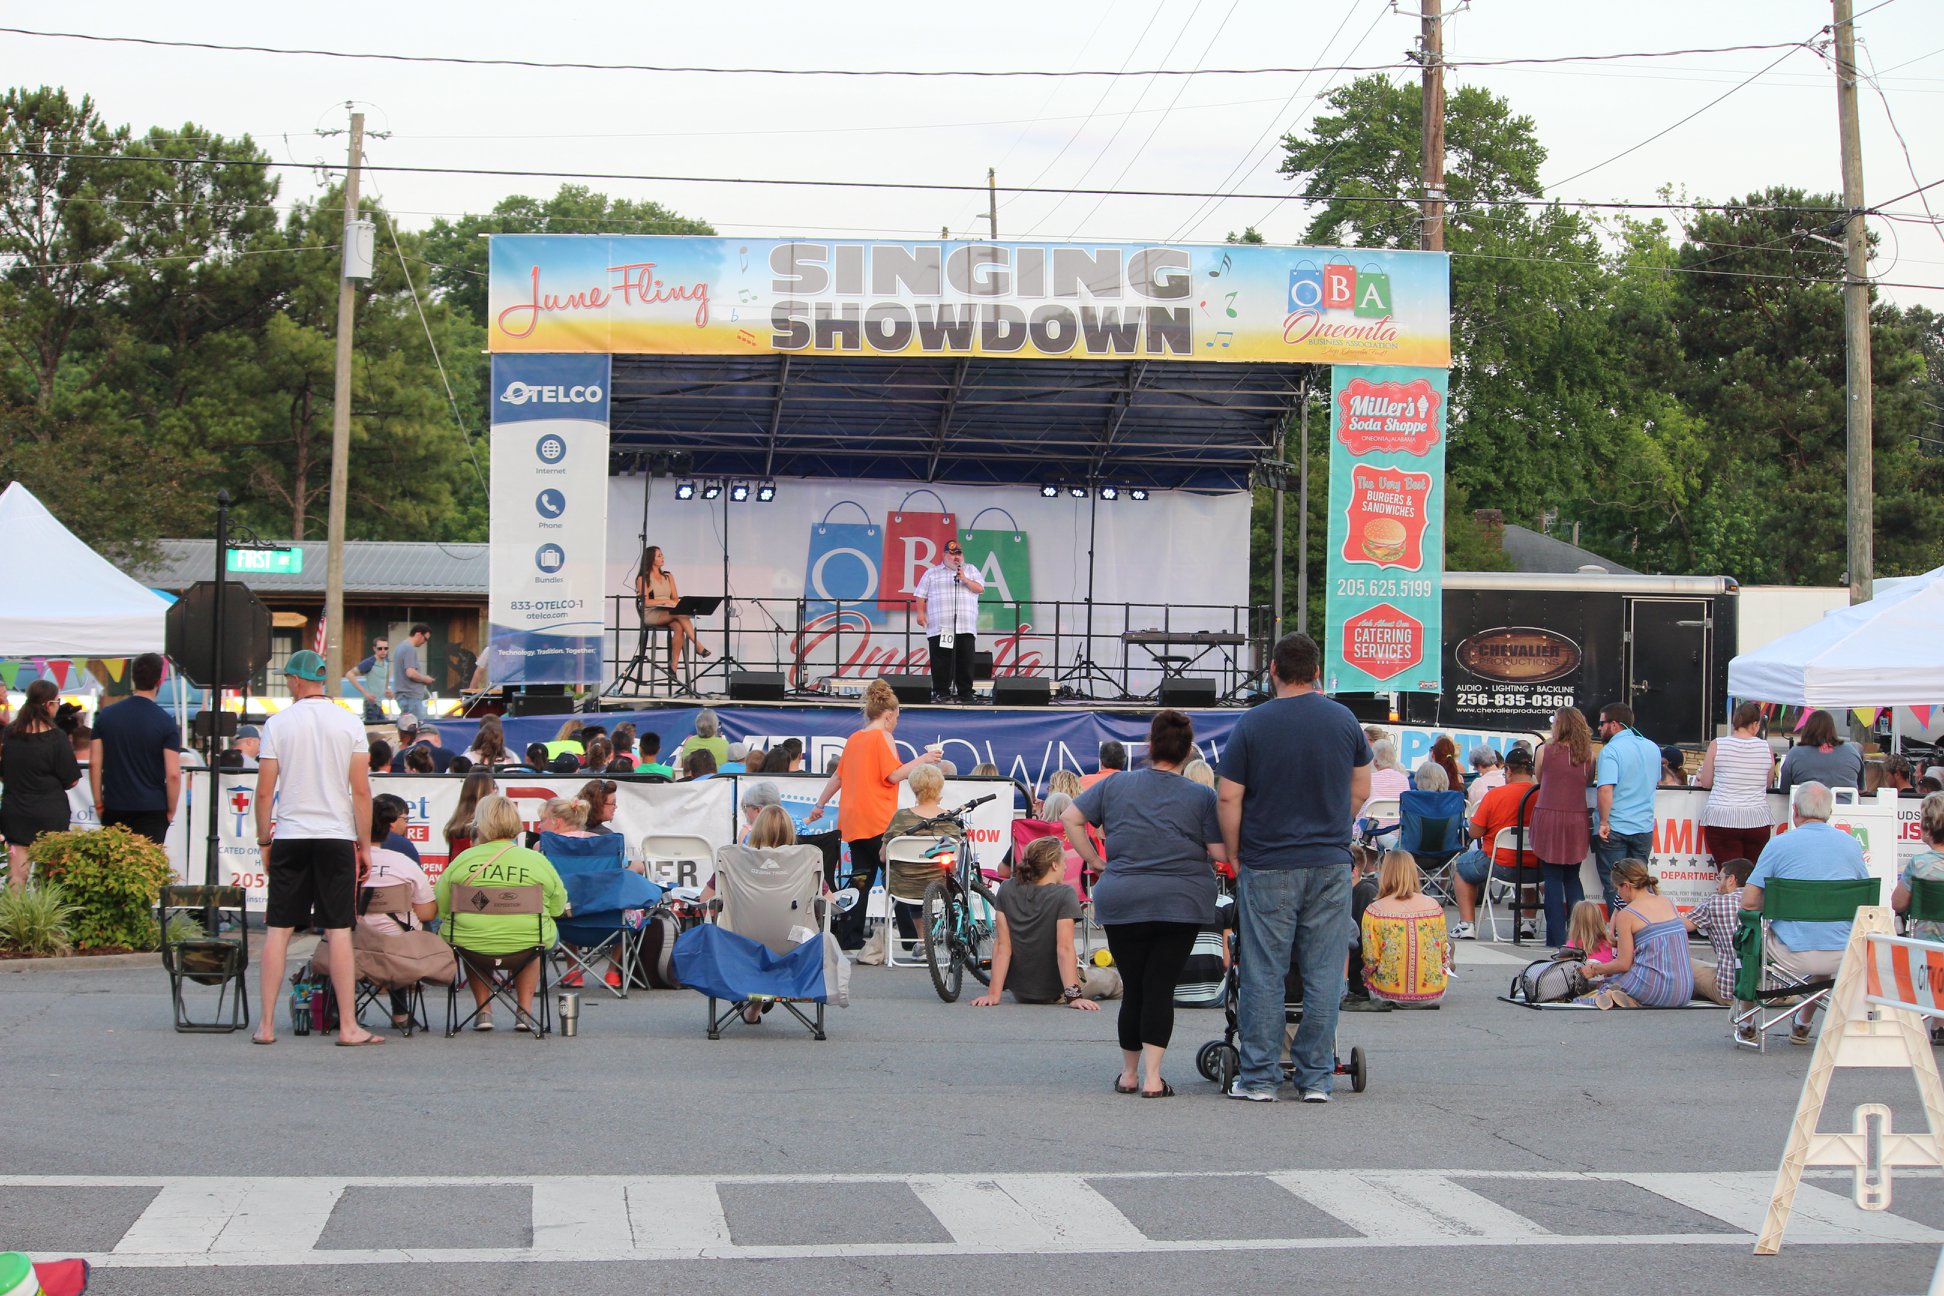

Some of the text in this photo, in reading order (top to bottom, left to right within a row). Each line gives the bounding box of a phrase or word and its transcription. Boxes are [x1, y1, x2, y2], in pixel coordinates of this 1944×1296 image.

[769, 243, 1193, 300] SINGING
[498, 263, 709, 338] June Fling
[770, 300, 1193, 356] SHOWDOWN
[1283, 308, 1404, 345] Oneonta
[1308, 338, 1398, 350] BUSINESS ASSOCIATION
[500, 381, 603, 405] OTELCO
[1350, 395, 1415, 417] Miller's
[1348, 417, 1428, 435] Soda Shoppe
[1357, 476, 1375, 489] The
[1404, 477, 1426, 491] Best
[1366, 490, 1413, 506] BURGERS &
[1361, 501, 1415, 518] SANDWICHES
[237, 549, 273, 569] FIRST
[1337, 579, 1432, 598] 205.625.5199
[510, 599, 583, 611] 833-OTELCO-1
[526, 612, 568, 620] otelco.com
[942, 634, 954, 644] 10
[1354, 628, 1412, 643] CATERING
[1354, 643, 1412, 659] SERVICES
[1479, 644, 1560, 658] CHEVALIER
[1478, 656, 1560, 666] PRODUCTIONS
[1491, 685, 1529, 693] LIGHTING
[1536, 685, 1575, 694] BACKLINE
[1456, 693, 1574, 708] 256-835-0360
